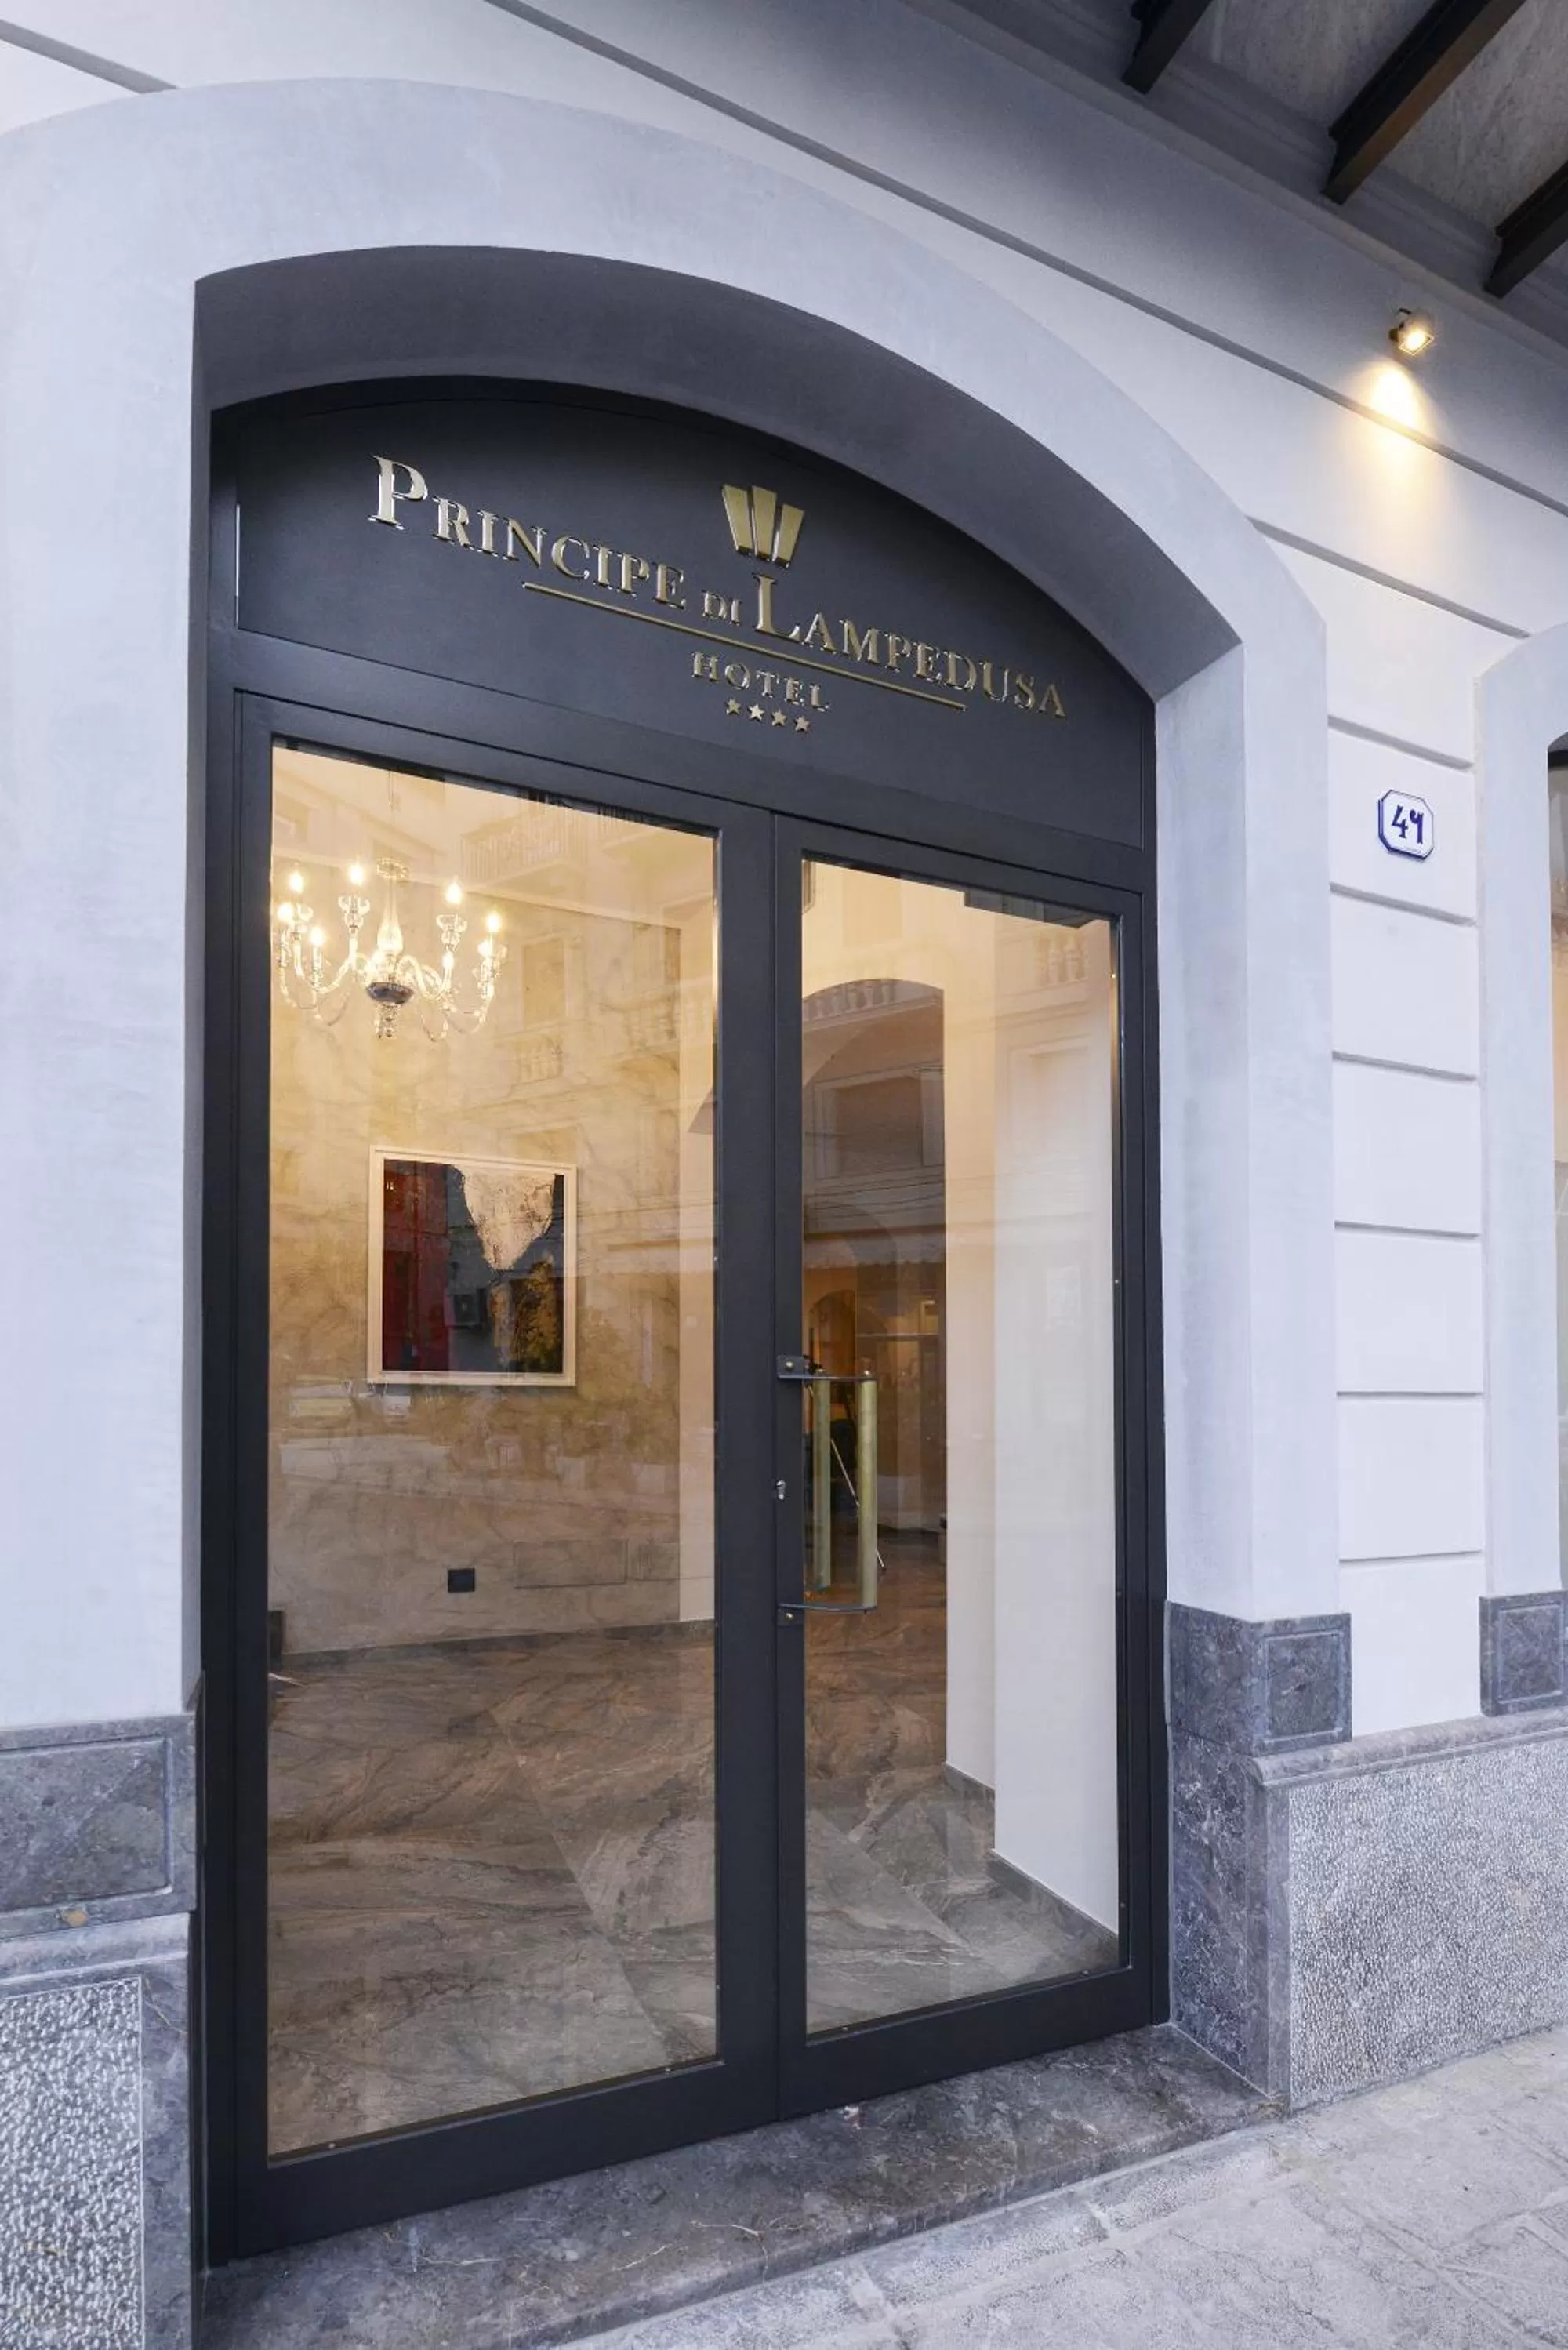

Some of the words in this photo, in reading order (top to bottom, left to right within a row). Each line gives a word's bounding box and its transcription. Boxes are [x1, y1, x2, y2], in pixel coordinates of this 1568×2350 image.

[368, 454, 686, 609] PRINCIPE
[702, 590, 742, 625] DI
[752, 573, 1067, 718] LAMPEDUSA
[692, 651, 829, 711] HOTEL
[1391, 805, 1424, 844] 49
